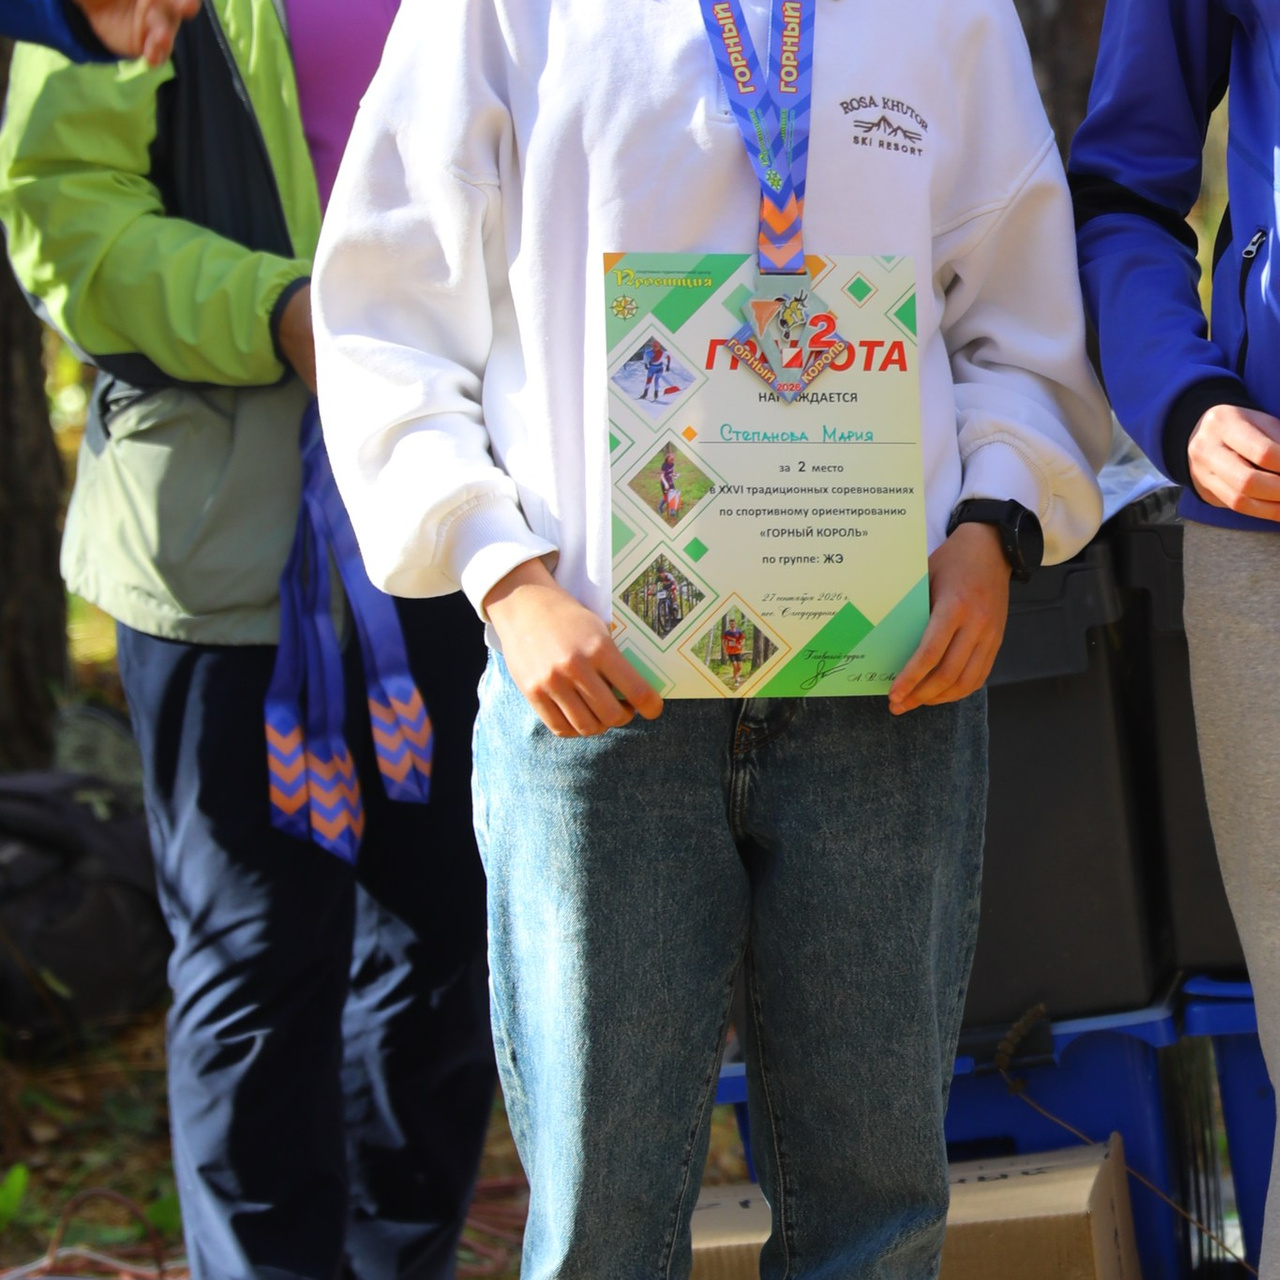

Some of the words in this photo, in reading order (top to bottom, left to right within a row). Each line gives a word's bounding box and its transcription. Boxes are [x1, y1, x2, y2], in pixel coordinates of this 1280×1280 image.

[713, 2, 756, 94] ГОРНЫЙ
[779, 1, 803, 94] ГОРНЫЙ
[840, 95, 878, 115] ROSA
[882, 97, 928, 133] KHUTOR
[853, 136, 872, 147] SKI
[878, 140, 923, 157] RESORT
[807, 313, 837, 349] 2
[728, 338, 777, 385] ГОРНЫЙ
[801, 340, 846, 384] КОРОЛЬ
[779, 464, 791, 473] за
[798, 461, 806, 473] 2
[811, 464, 844, 473] место
[709, 486, 716, 495] в
[719, 485, 744, 495] XXVI
[746, 486, 829, 497] традиционных
[831, 486, 915, 497] соревнованиях
[719, 508, 733, 517] по
[736, 508, 809, 520] спортивному
[812, 508, 907, 520] ориентированию
[760, 527, 814, 538] «ГОРНЫЙ
[816, 527, 868, 538] КОРОЛЬ»
[762, 556, 776, 565] по
[779, 556, 820, 567] группе:
[823, 554, 844, 565] ЖЭ
